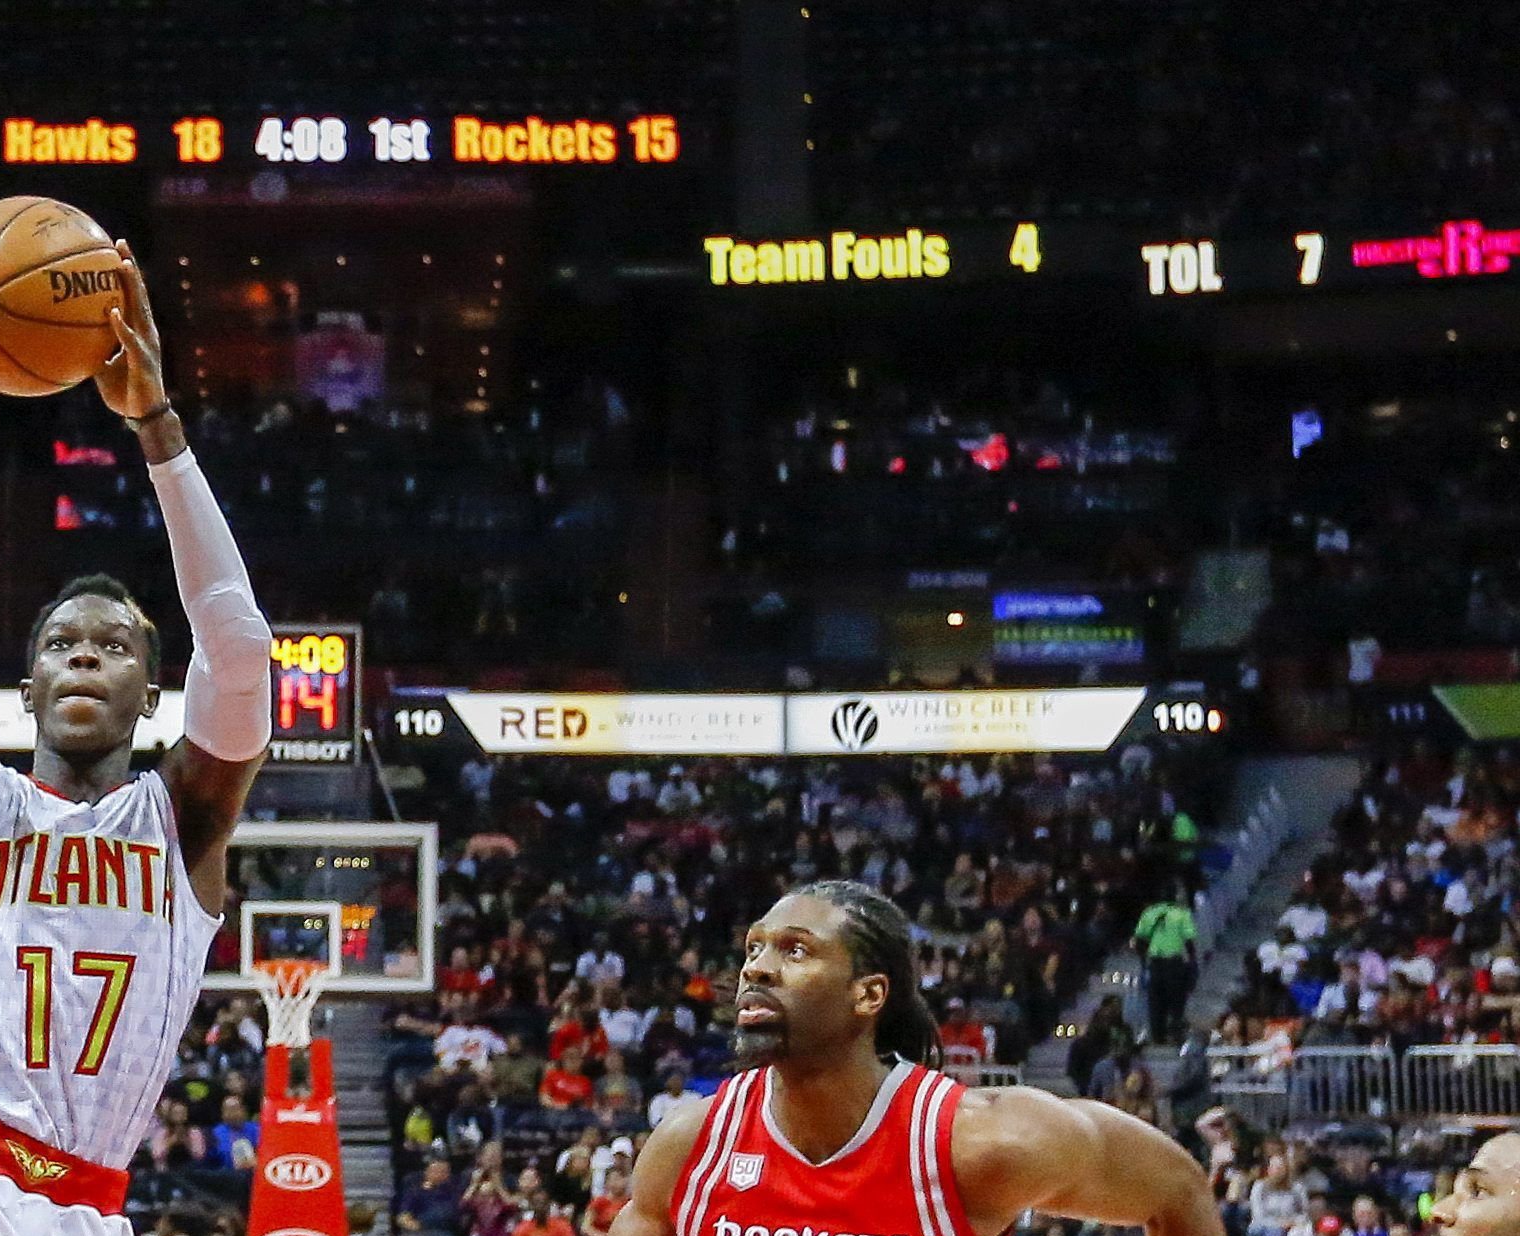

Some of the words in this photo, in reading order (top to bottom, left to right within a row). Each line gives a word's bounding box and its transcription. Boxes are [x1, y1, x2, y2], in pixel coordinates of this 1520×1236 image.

[3, 117, 136, 163] Hawks
[174, 117, 222, 163] 18
[255, 117, 347, 163] 4:08
[368, 119, 431, 163] 1st
[453, 115, 618, 163] Rockets
[629, 116, 679, 162] 15
[704, 237, 826, 285] Team
[831, 228, 950, 280] Fouls
[1009, 223, 1041, 273] 4
[1142, 241, 1223, 295] TOL
[1295, 233, 1324, 285] 7
[270, 634, 345, 675] 4:08
[278, 675, 338, 730] 14
[394, 710, 445, 737] 110
[499, 707, 588, 740] RED
[1153, 703, 1205, 732] 110
[16, 945, 136, 1076] 17
[276, 1163, 320, 1183] KIA
